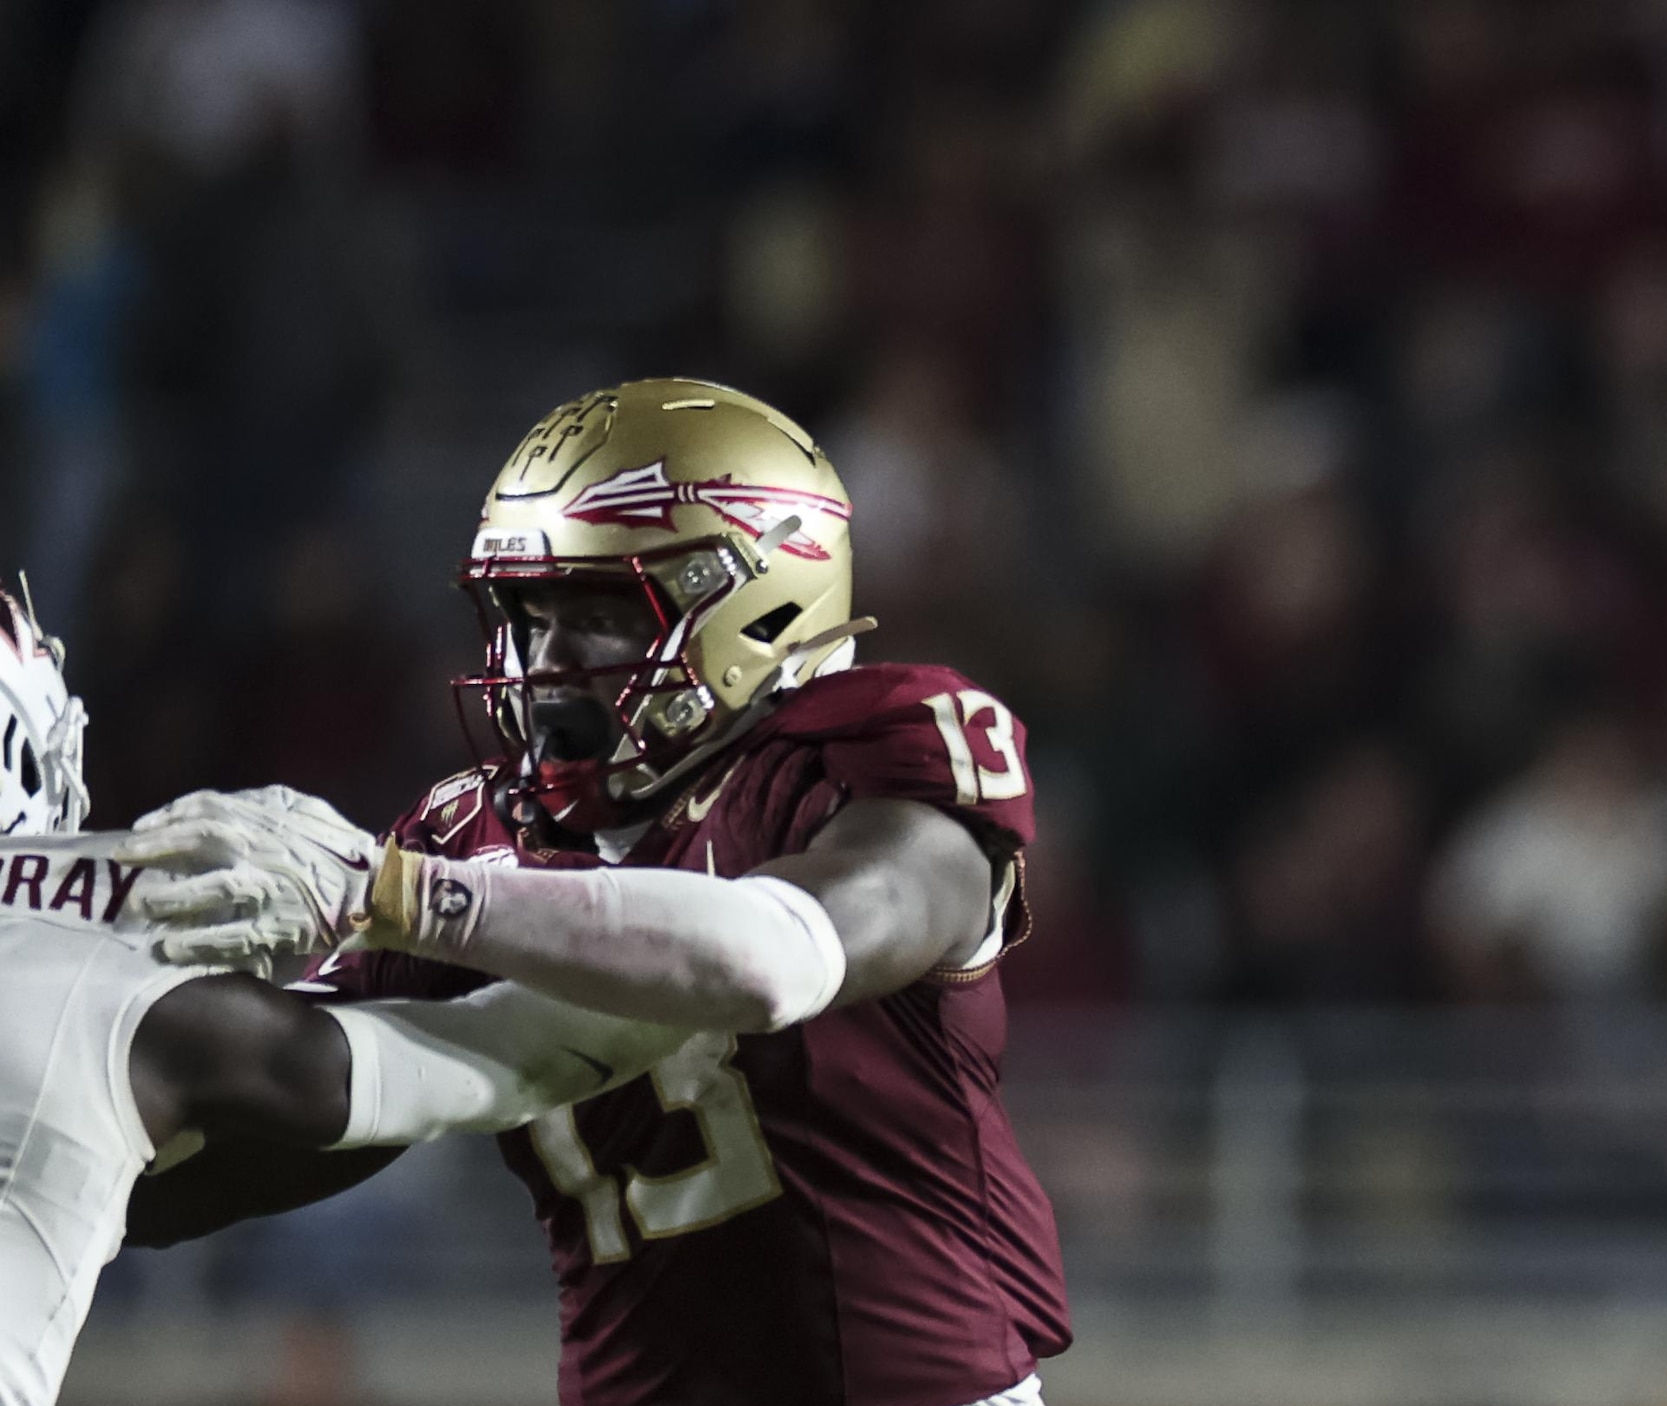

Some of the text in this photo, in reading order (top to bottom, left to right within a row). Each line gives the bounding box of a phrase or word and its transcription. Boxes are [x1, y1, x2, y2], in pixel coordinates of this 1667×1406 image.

[920, 689, 1028, 806] 13
[0, 853, 145, 923] RAY
[528, 1031, 785, 1266] 13
